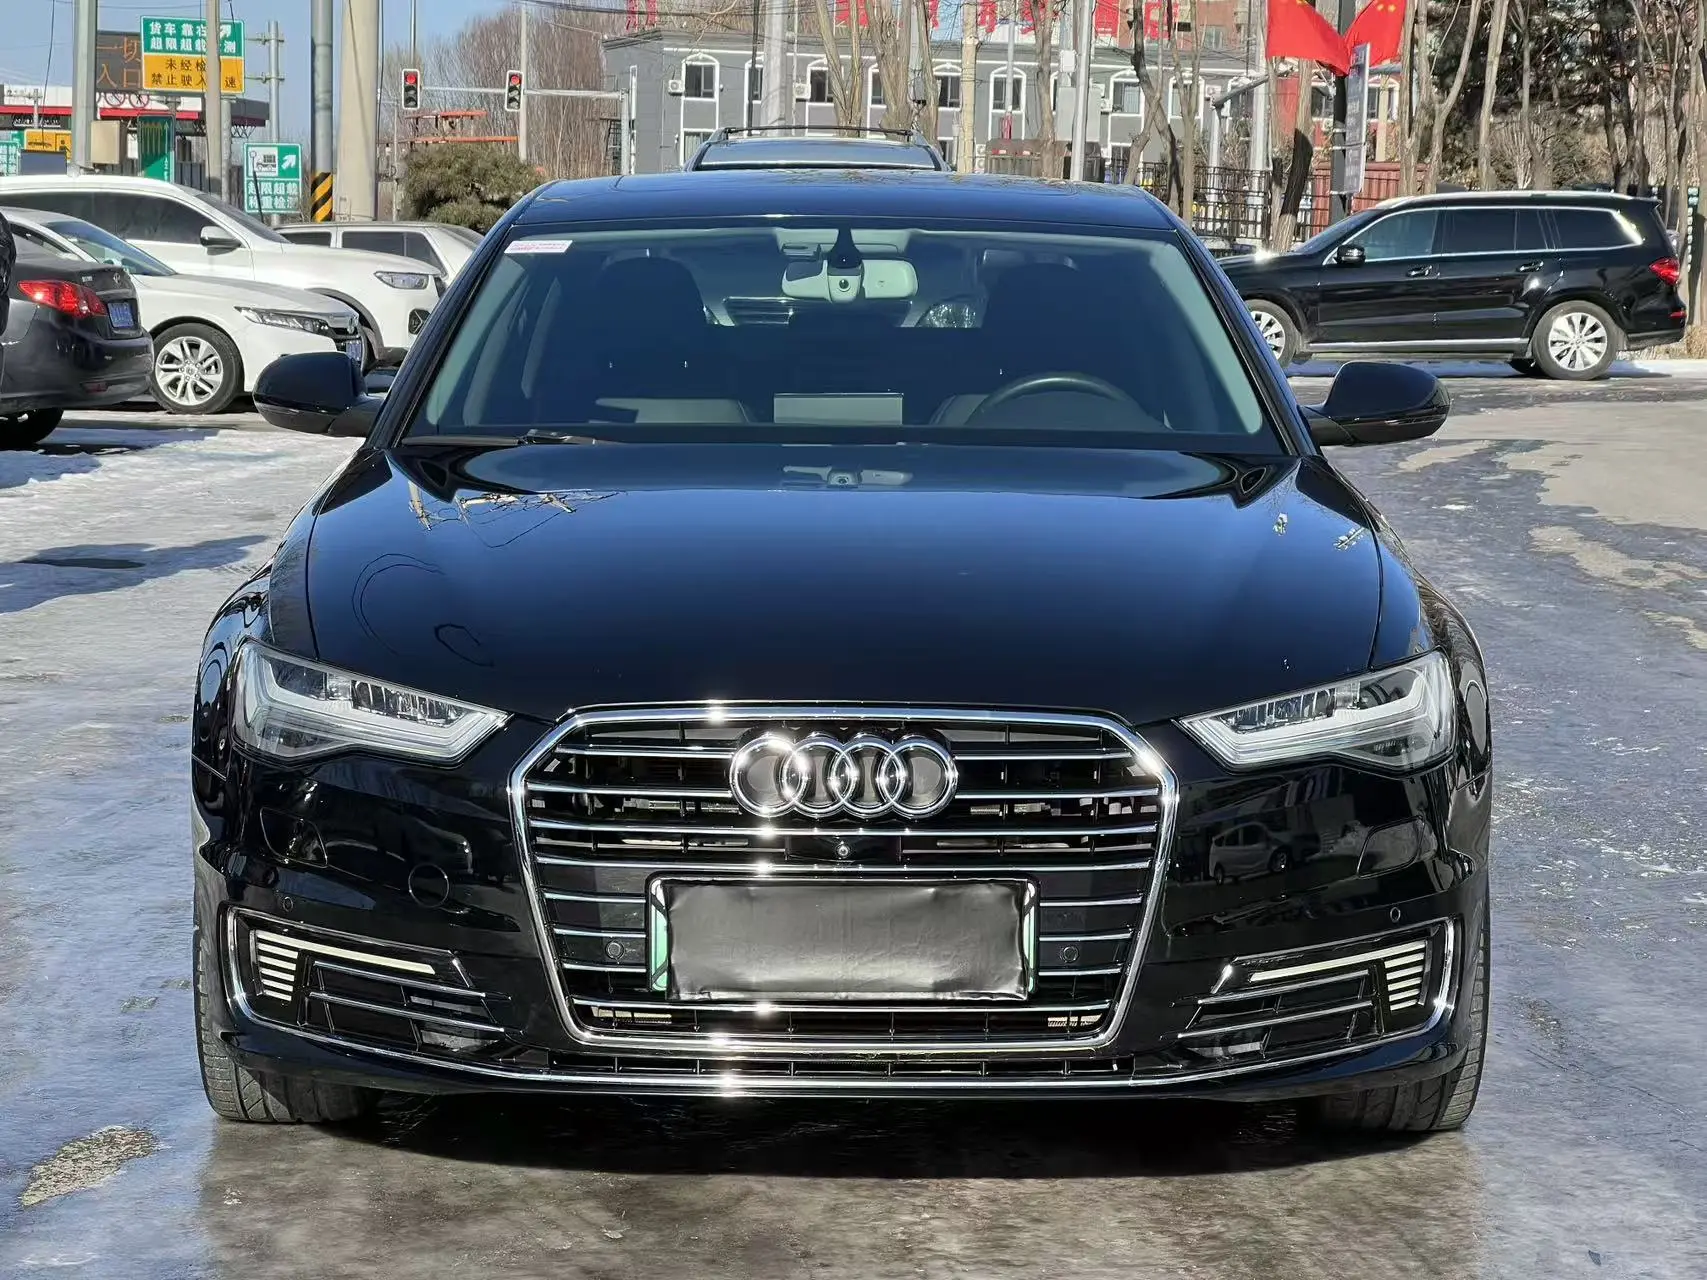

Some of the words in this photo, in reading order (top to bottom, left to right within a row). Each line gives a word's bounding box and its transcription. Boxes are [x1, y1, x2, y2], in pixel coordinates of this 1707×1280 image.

[150, 36, 236, 53] 超限超载测
[96, 63, 141, 88] 入口
[151, 73, 236, 88] 禁止驶入速
